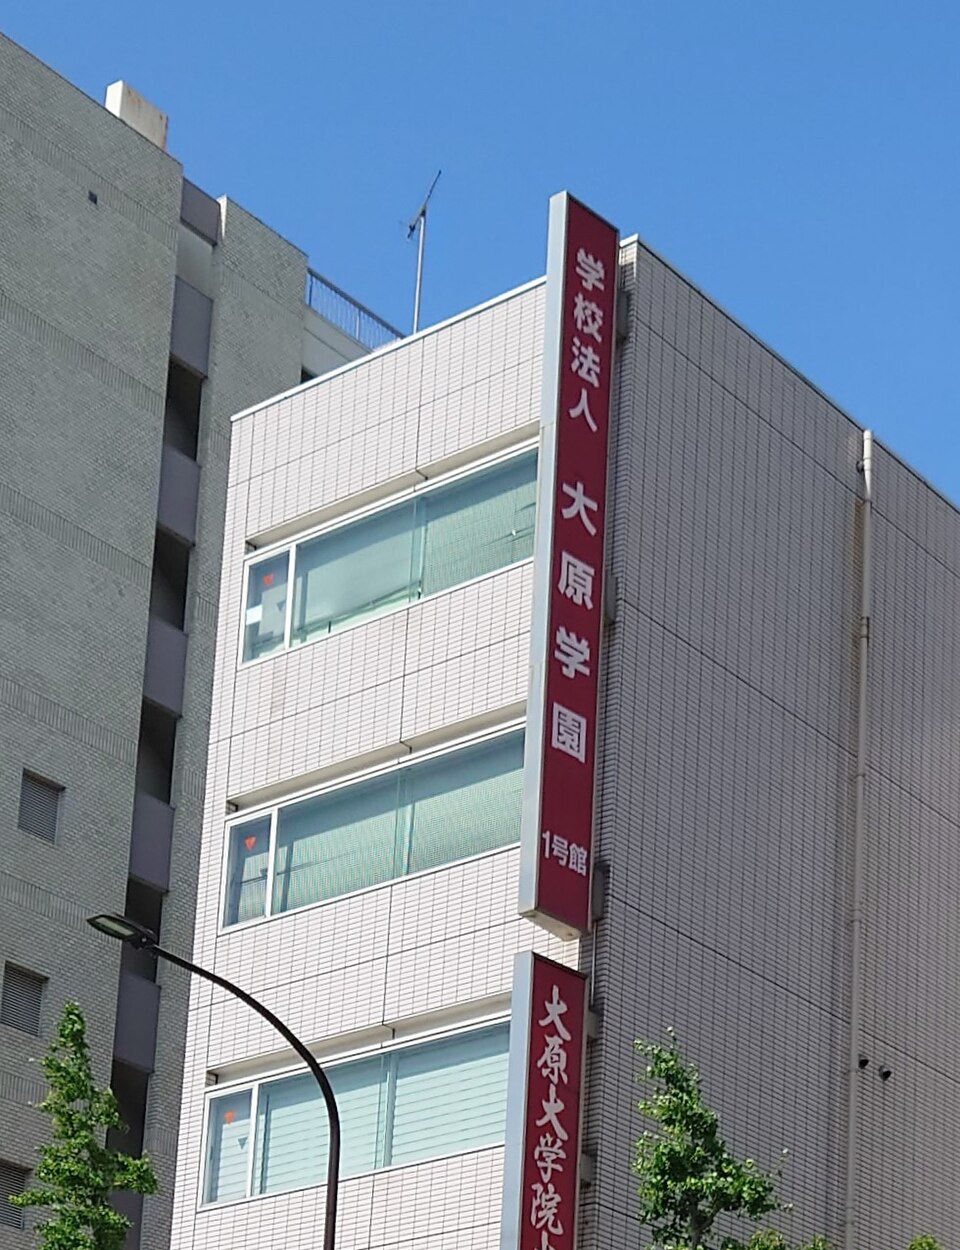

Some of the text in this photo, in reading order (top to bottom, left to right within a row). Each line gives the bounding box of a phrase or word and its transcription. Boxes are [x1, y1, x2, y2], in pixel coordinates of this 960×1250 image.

[551, 248, 605, 764] 学校法人 大原学園
[542, 829, 588, 878] 1号館
